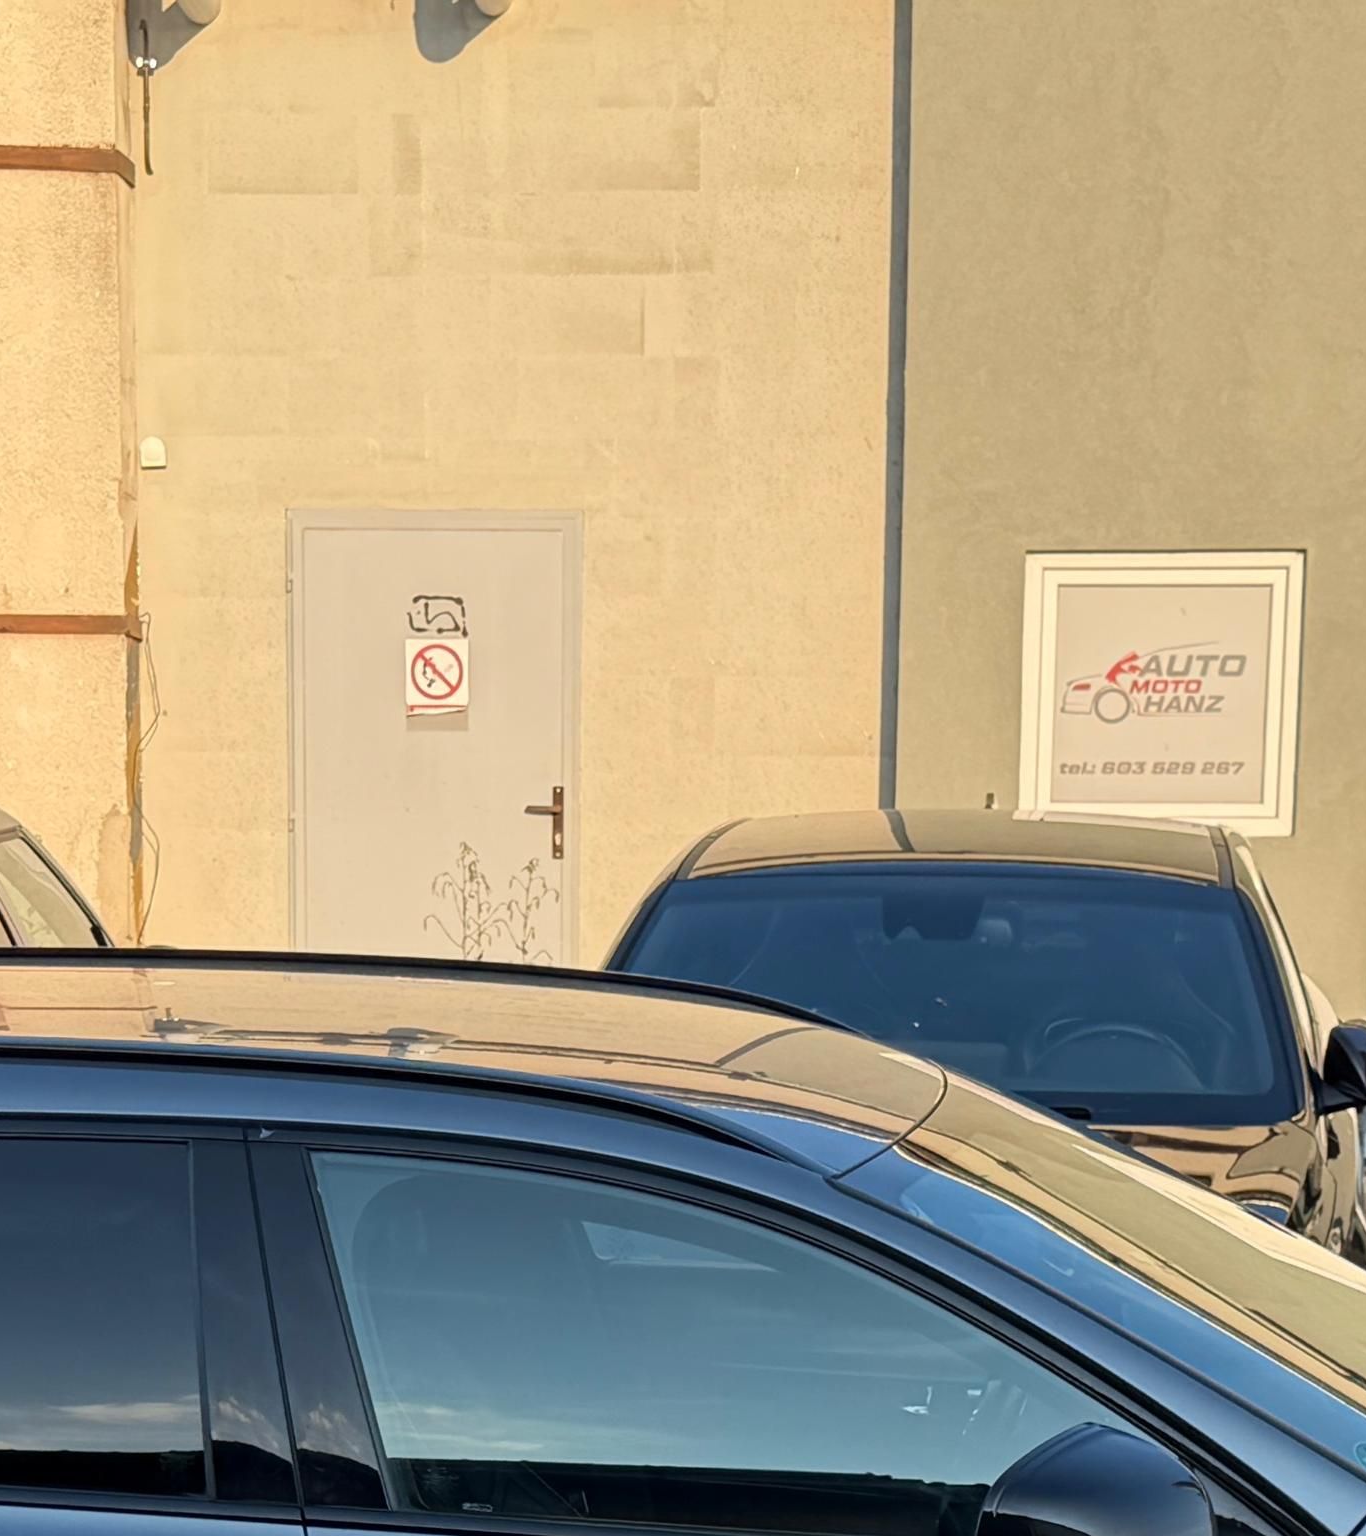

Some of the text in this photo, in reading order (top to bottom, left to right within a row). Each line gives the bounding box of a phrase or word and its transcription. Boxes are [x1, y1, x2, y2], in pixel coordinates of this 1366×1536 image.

[1139, 654, 1247, 677] AUTO
[1130, 680, 1202, 694] MOTO
[1143, 695, 1225, 713] HANZ
[1101, 761, 1146, 775] 603
[1201, 761, 1245, 775] 267
